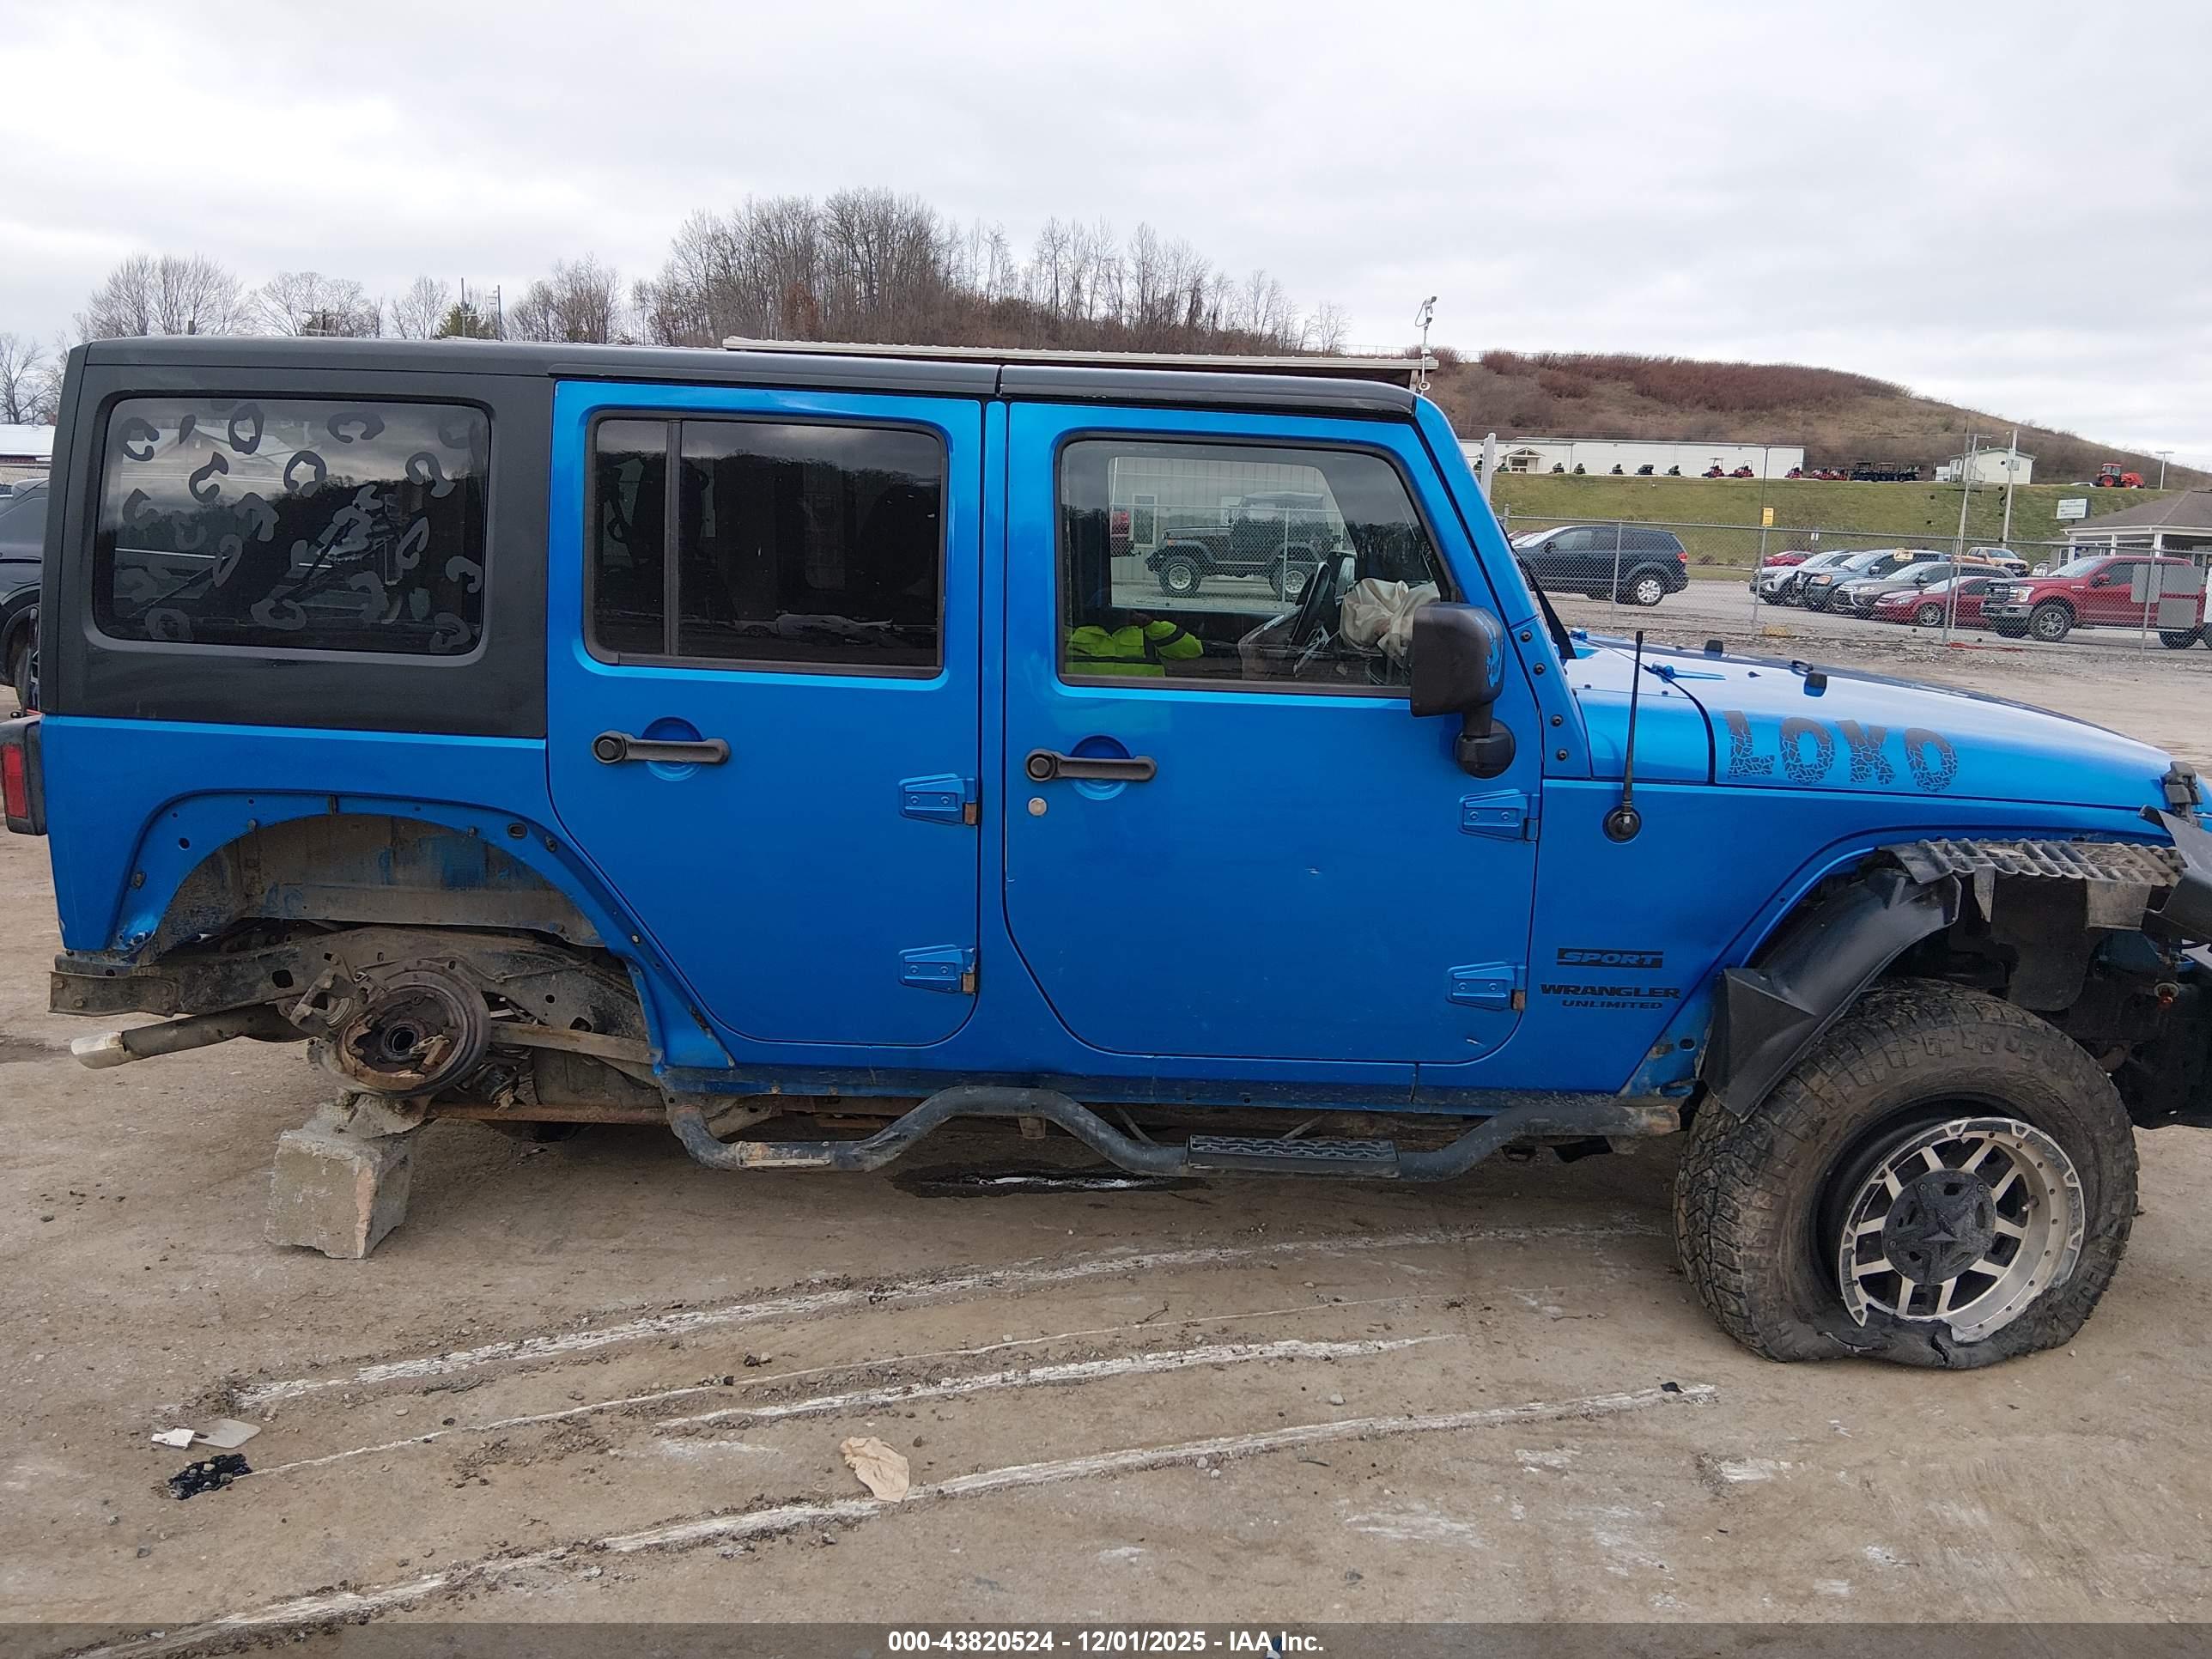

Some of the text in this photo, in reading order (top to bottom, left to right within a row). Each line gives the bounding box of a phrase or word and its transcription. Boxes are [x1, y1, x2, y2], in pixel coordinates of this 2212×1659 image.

[1560, 951, 1658, 965] SPORT
[1540, 984, 1680, 999] WRANGLER
[1562, 1000, 1663, 1010] UNLIMITED
